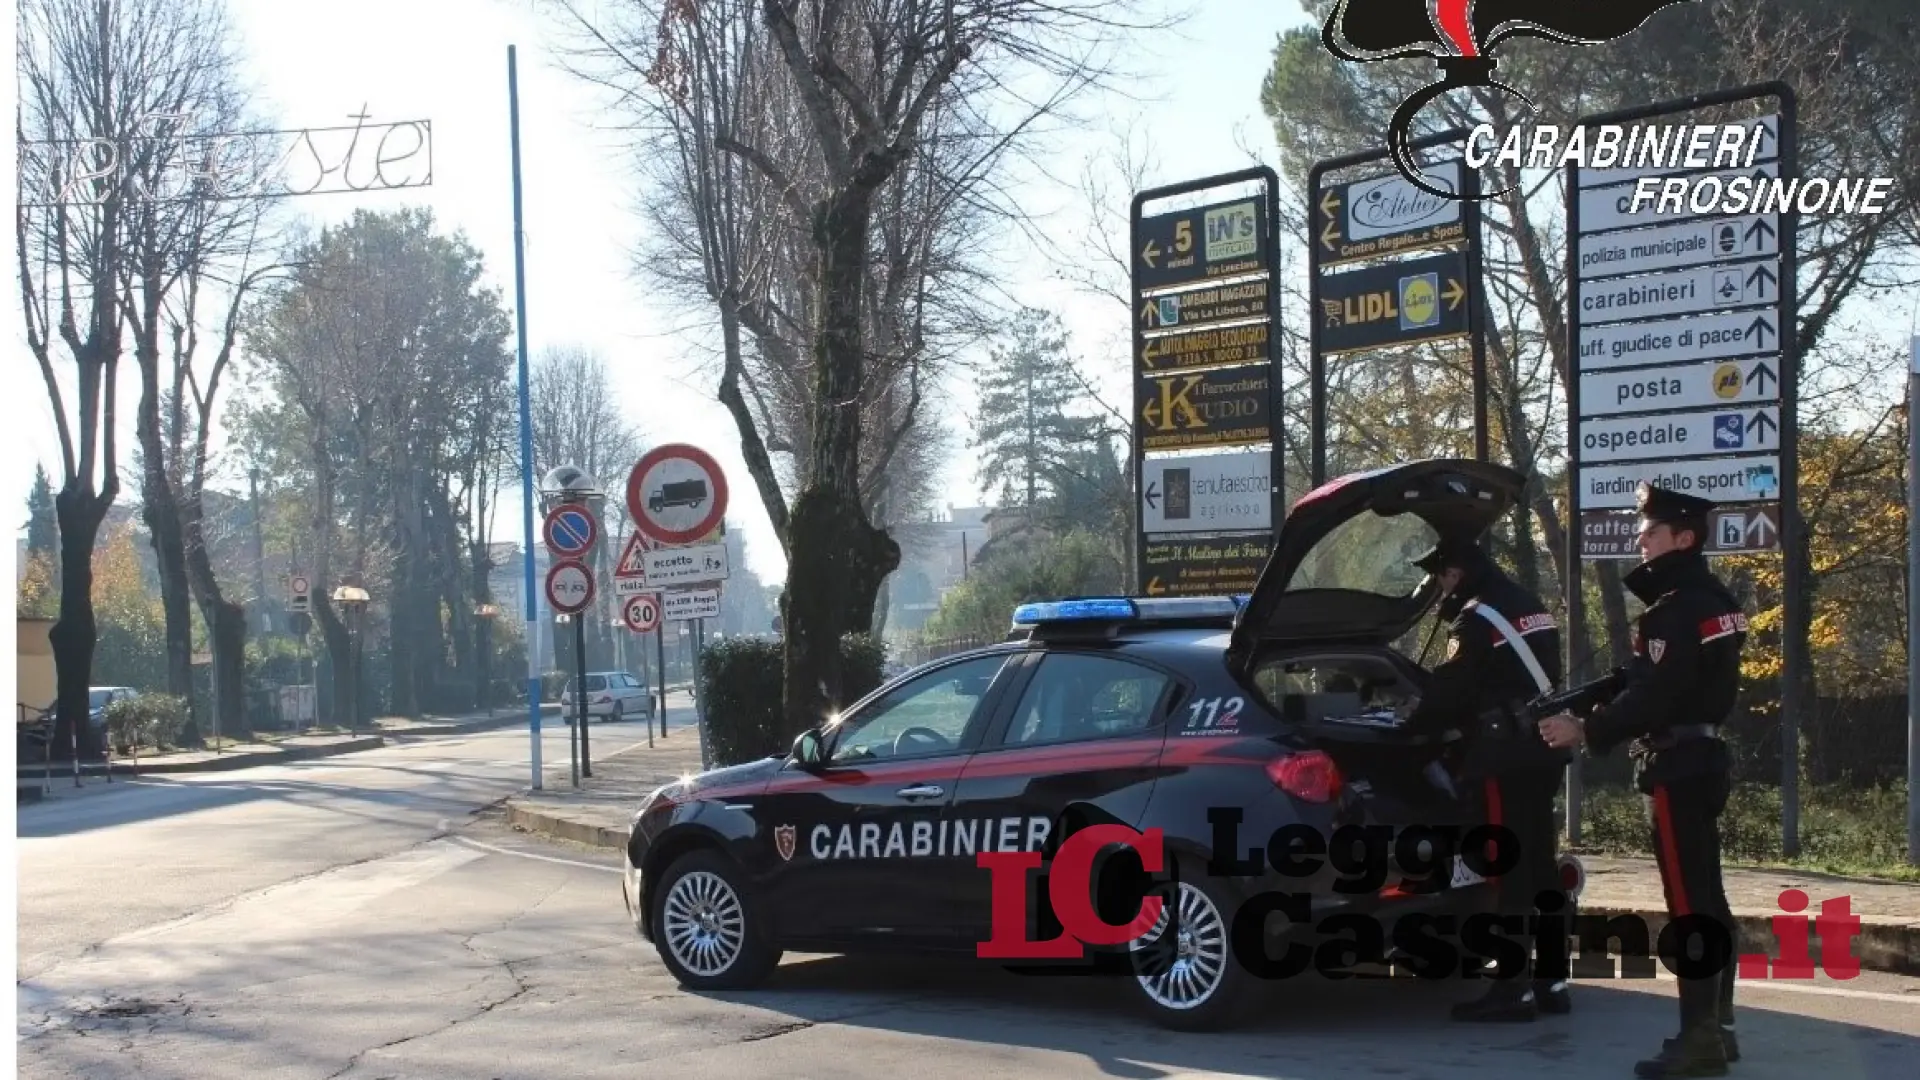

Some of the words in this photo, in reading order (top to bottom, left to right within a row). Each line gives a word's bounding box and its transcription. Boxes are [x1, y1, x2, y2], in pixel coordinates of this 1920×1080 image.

[1368, 187, 1441, 222] Atelier
[1174, 219, 1193, 252] 5
[1341, 241, 1376, 256] Centro
[1433, 222, 1464, 240] Sposi
[1582, 245, 1626, 268] polizia
[1630, 235, 1707, 259] municipale
[1344, 291, 1399, 325] LIDL
[1583, 278, 1696, 311] carabinieri
[1182, 310, 1199, 321] Via
[1580, 340, 1605, 358] uff.
[1611, 333, 1673, 358] giudice
[1678, 329, 1693, 346] di
[1699, 327, 1742, 349] pace
[1156, 374, 1208, 430] K
[1617, 376, 1682, 405] posta
[1583, 423, 1688, 452] ospedale
[1652, 473, 1693, 490] dello
[1697, 470, 1744, 492] sport
[654, 556, 693, 568] eccetto
[1583, 540, 1618, 553] torre
[632, 605, 653, 623] 30
[1187, 696, 1245, 728] 112
[810, 817, 1056, 859] CARABINIER
